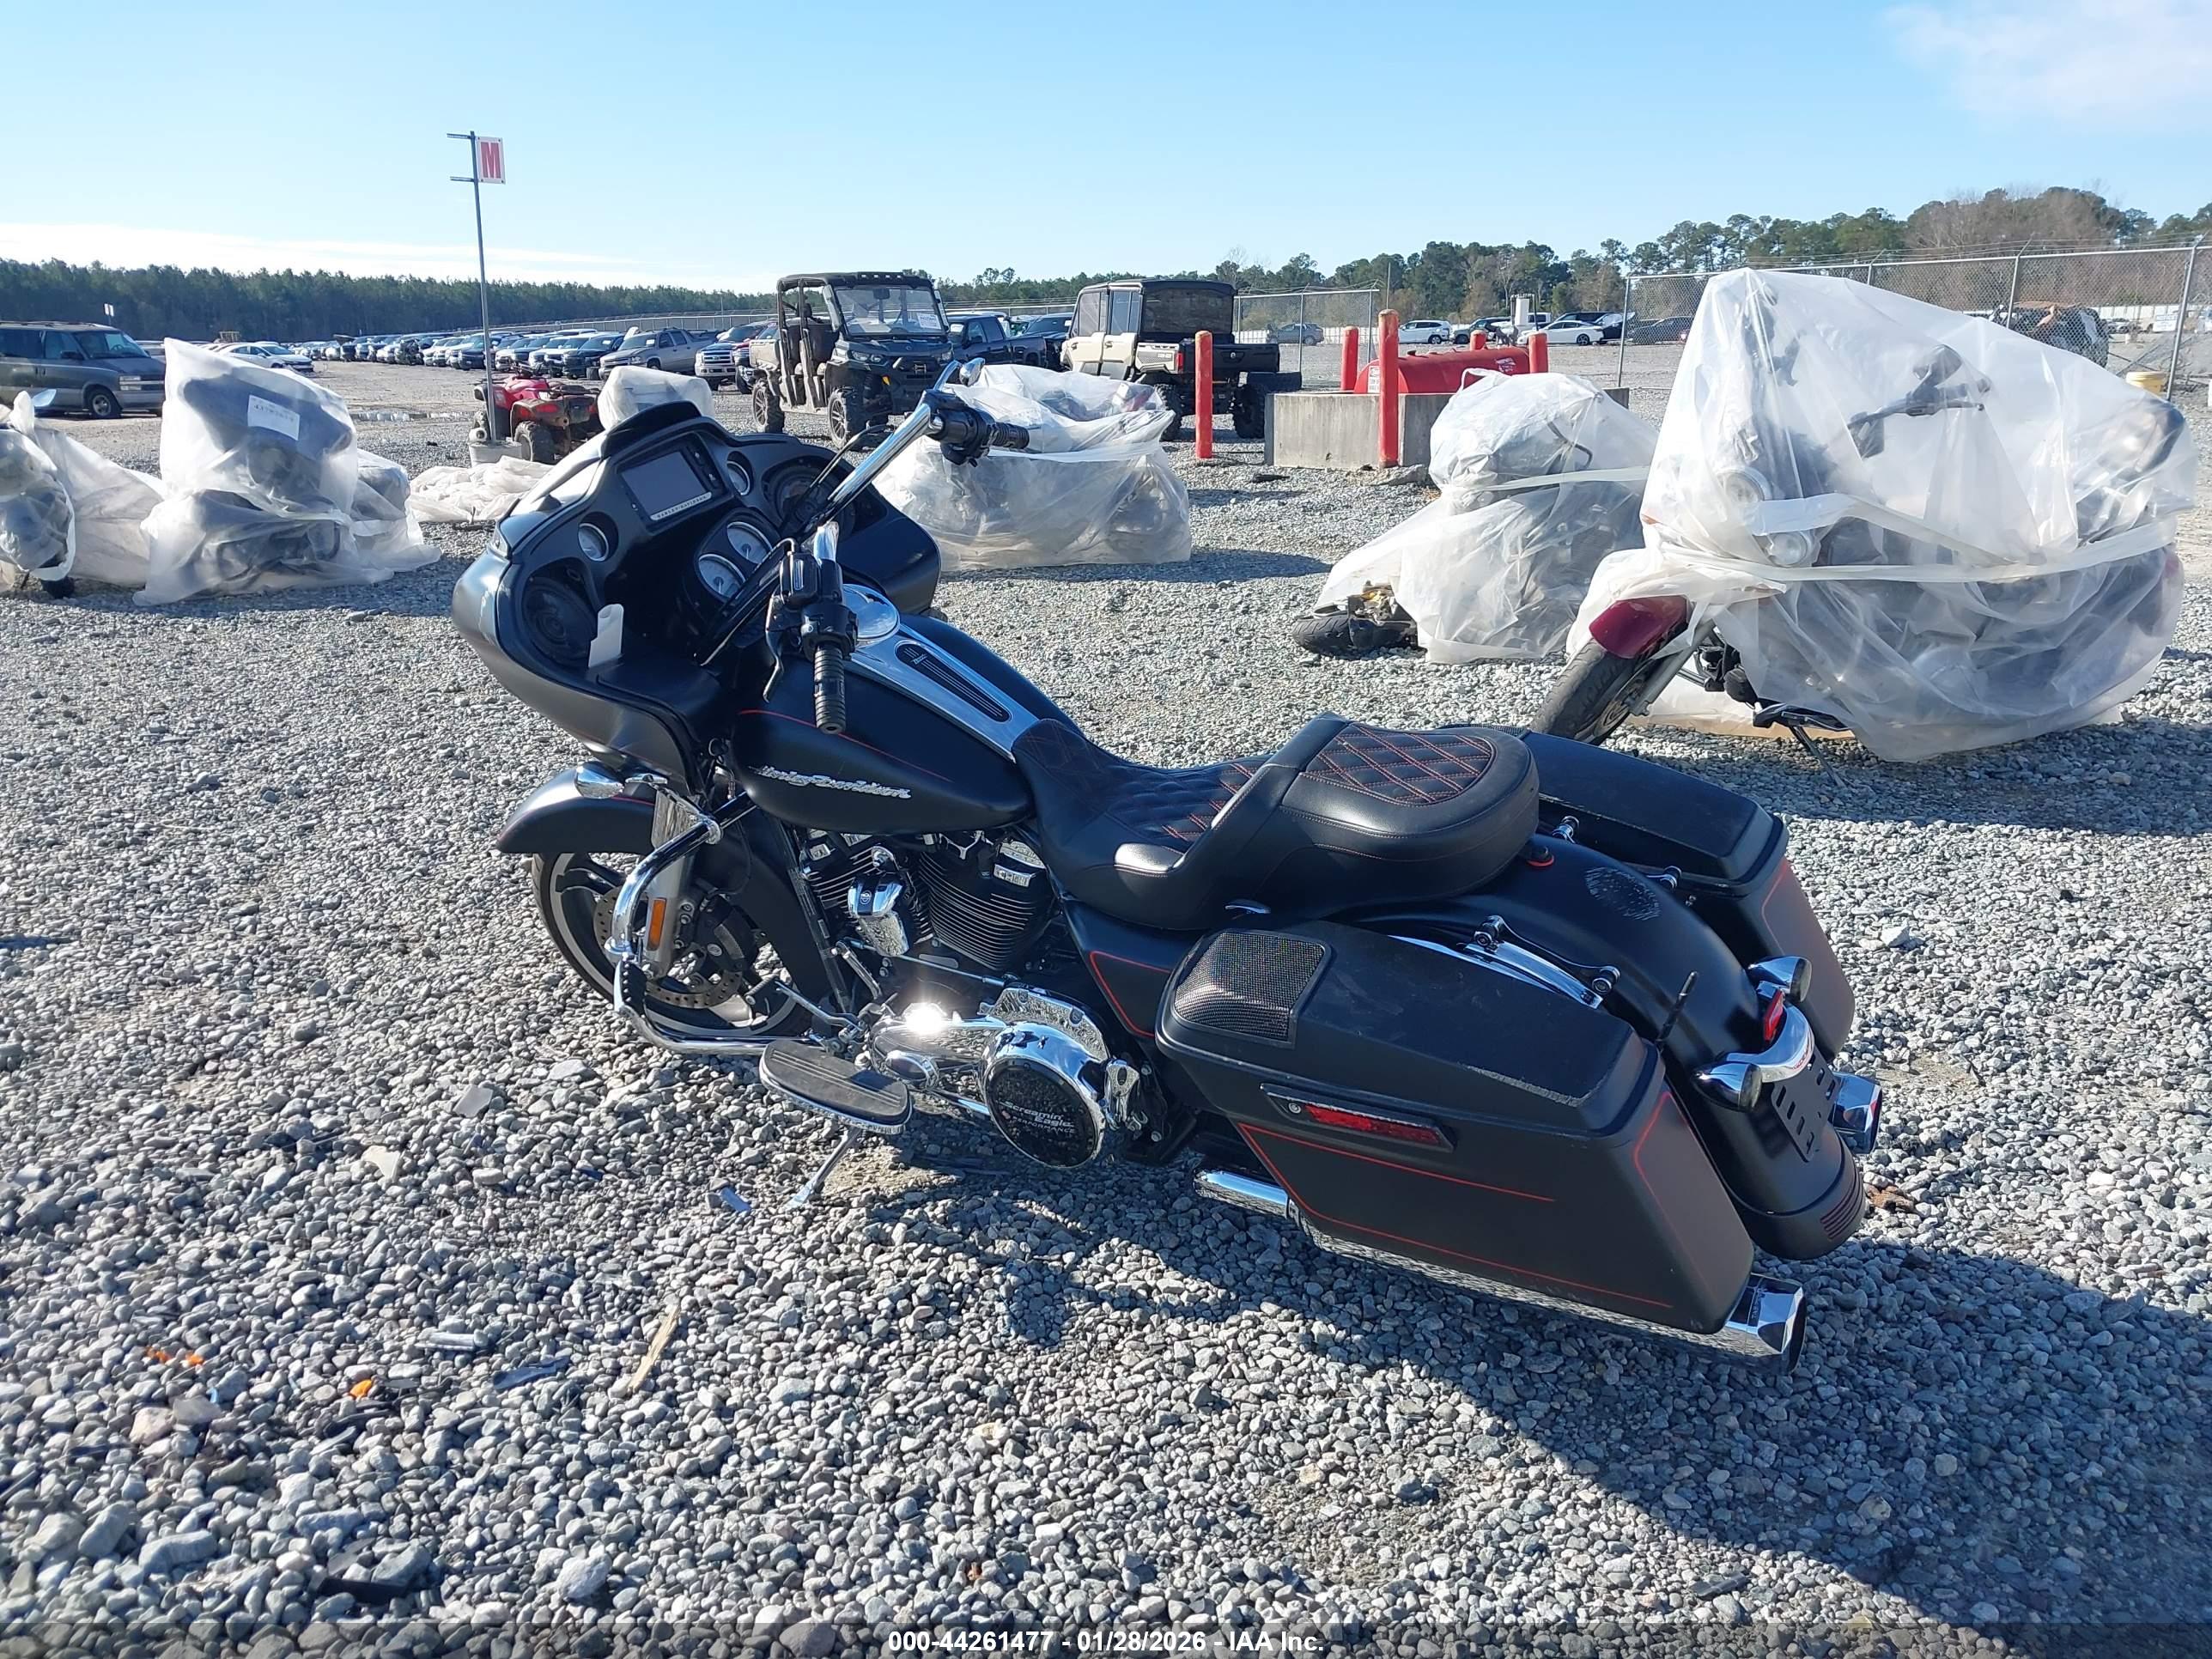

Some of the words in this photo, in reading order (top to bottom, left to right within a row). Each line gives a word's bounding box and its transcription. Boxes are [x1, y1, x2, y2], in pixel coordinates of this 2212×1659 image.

[481, 142, 501, 179] M
[1012, 1115, 1076, 1133] PERFORMANCE
[1034, 1116, 1074, 1127] Eagle
